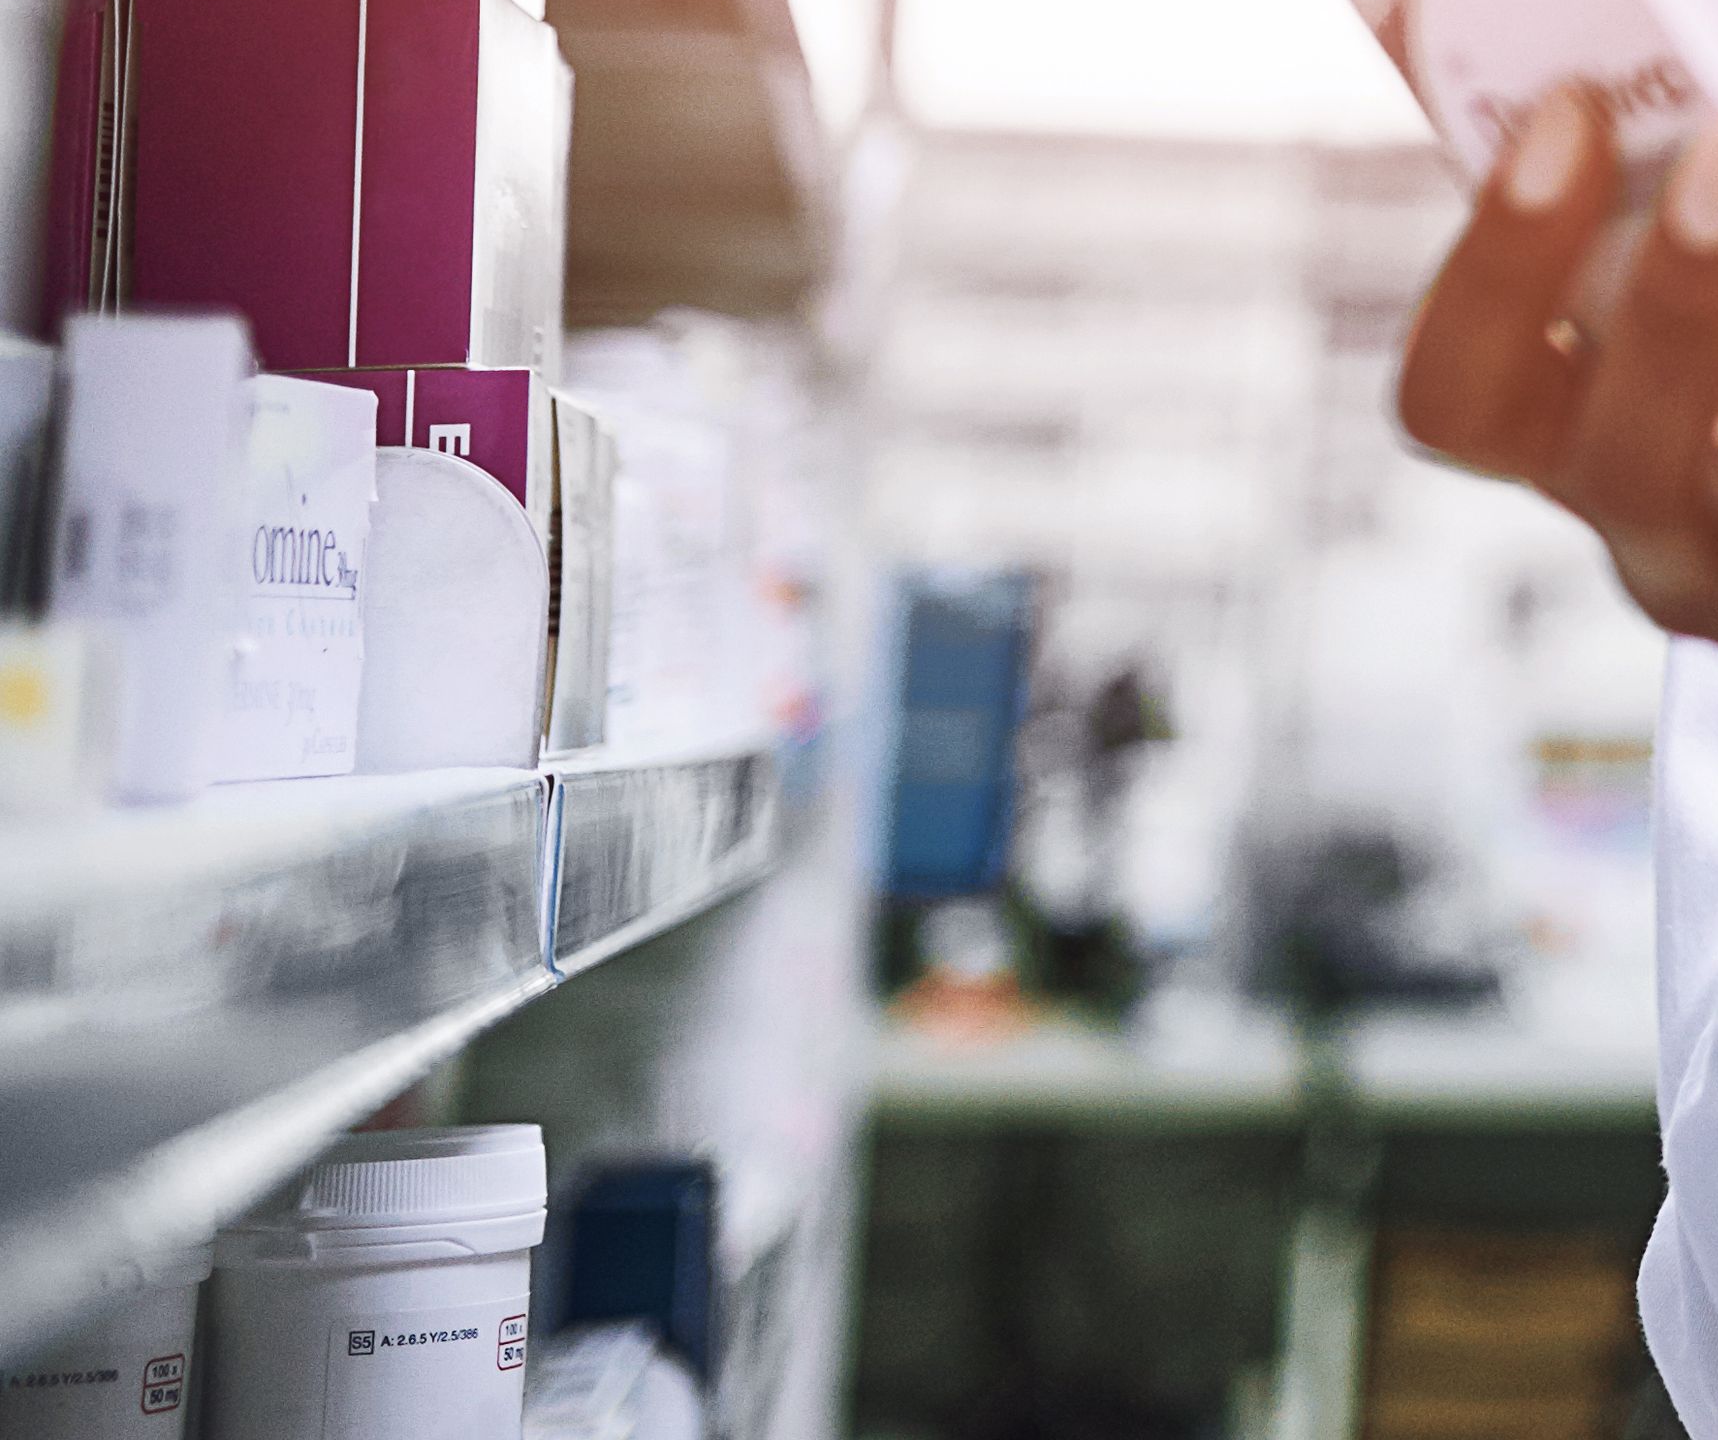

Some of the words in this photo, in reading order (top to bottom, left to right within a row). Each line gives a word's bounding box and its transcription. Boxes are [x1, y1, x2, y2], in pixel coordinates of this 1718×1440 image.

[352, 1336, 371, 1350] S5
[381, 1335, 395, 1347] A:
[397, 1332, 427, 1346] 2.6.5
[503, 1347, 514, 1361] 50
[150, 1389, 163, 1405] 50
